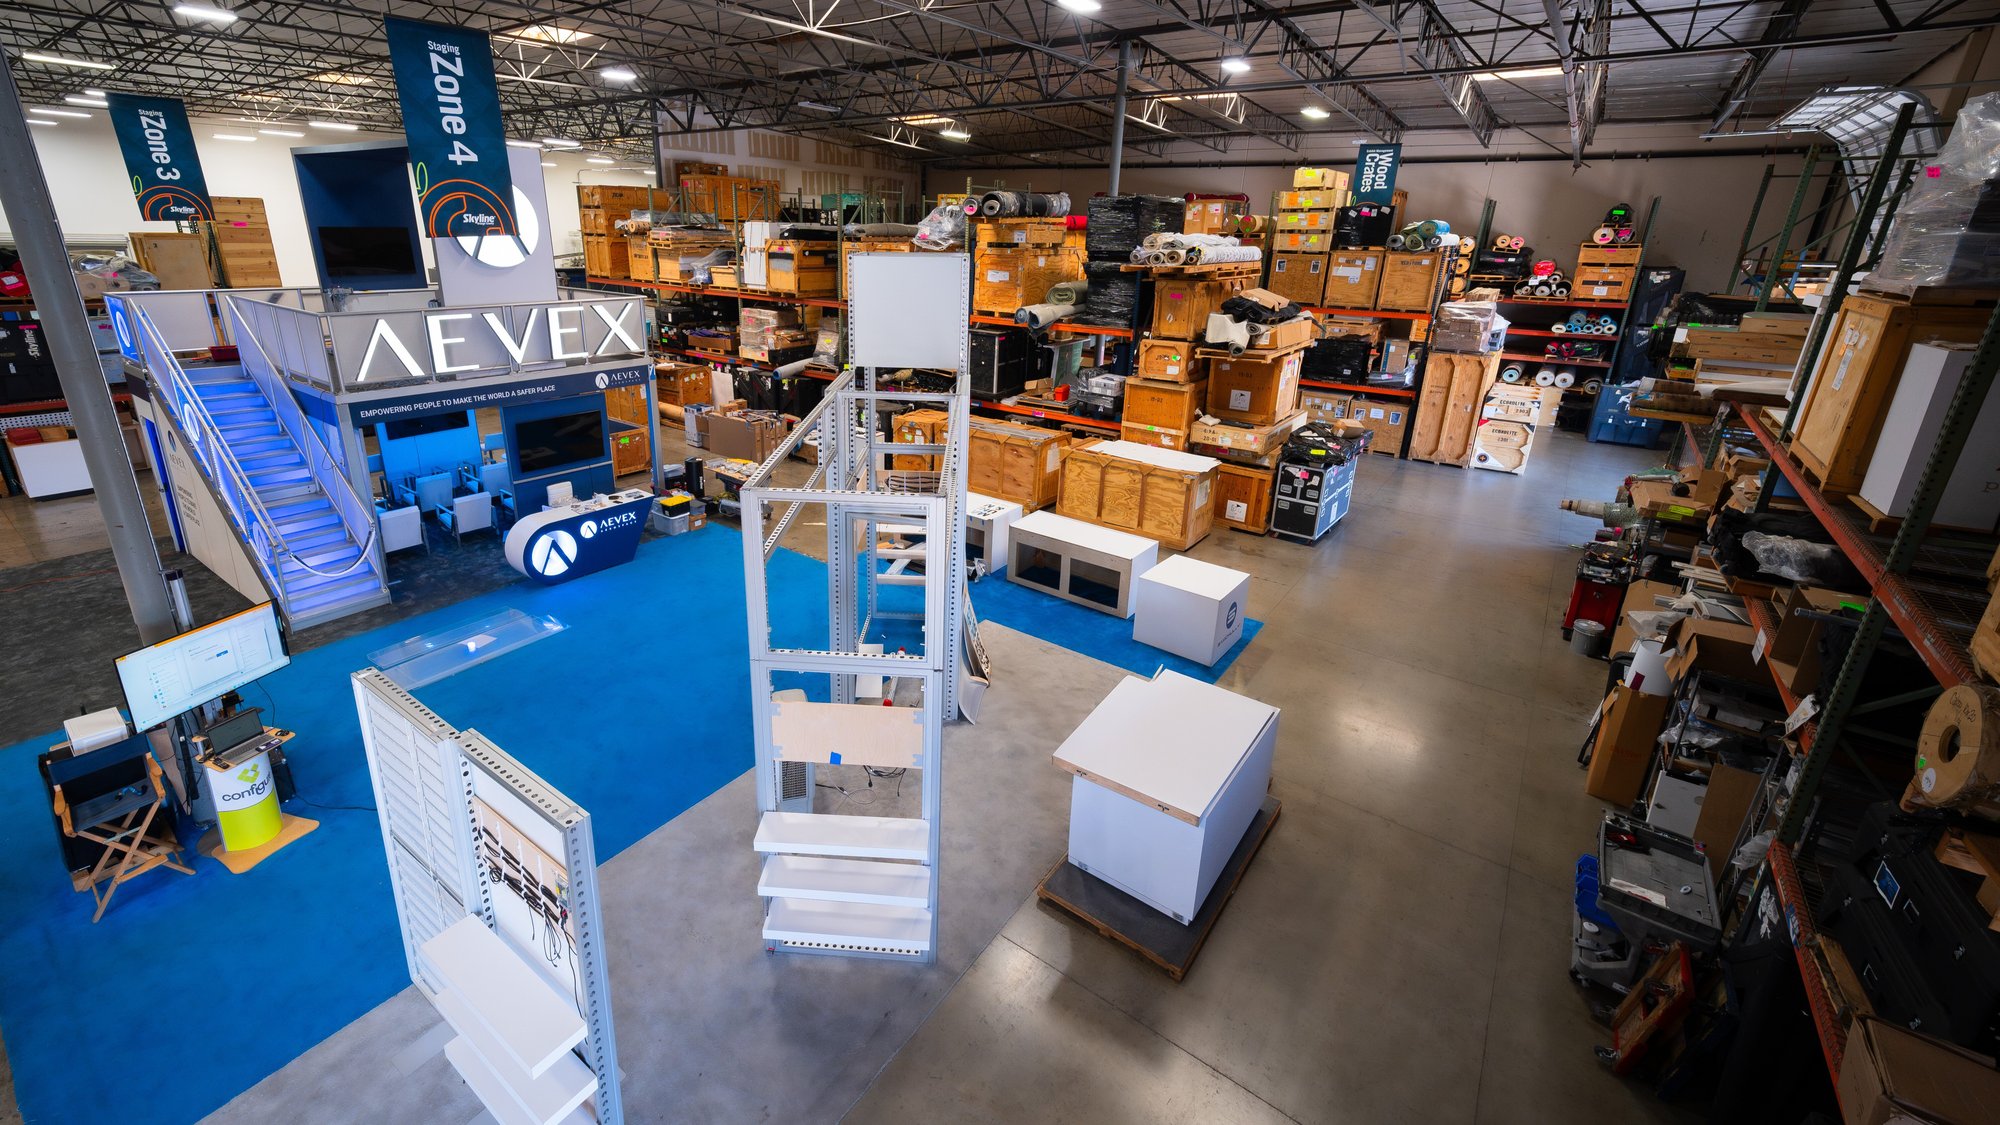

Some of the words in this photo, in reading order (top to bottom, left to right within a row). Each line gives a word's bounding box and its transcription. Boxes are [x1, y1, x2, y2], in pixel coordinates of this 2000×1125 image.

[427, 40, 461, 55] Staging
[430, 52, 467, 135] Zone
[138, 109, 164, 117] Staging
[140, 116, 171, 164] Zone
[156, 167, 181, 180] 3
[448, 140, 479, 165] 4
[1360, 153, 1380, 192] Crates
[1374, 152, 1394, 189] Wood
[463, 213, 494, 223] Skyline
[24, 329, 40, 358] Skyline
[356, 303, 641, 382] AEVEX
[610, 370, 640, 381] AEVEX
[360, 404, 413, 418] EMPOWERING
[413, 401, 441, 411] PEOPLE
[453, 396, 473, 405] MAKE
[473, 394, 487, 402] THE
[487, 391, 510, 401] WORLD
[516, 387, 537, 396] SAFER
[537, 385, 556, 393] PLACE
[600, 511, 637, 528] AEVEX
